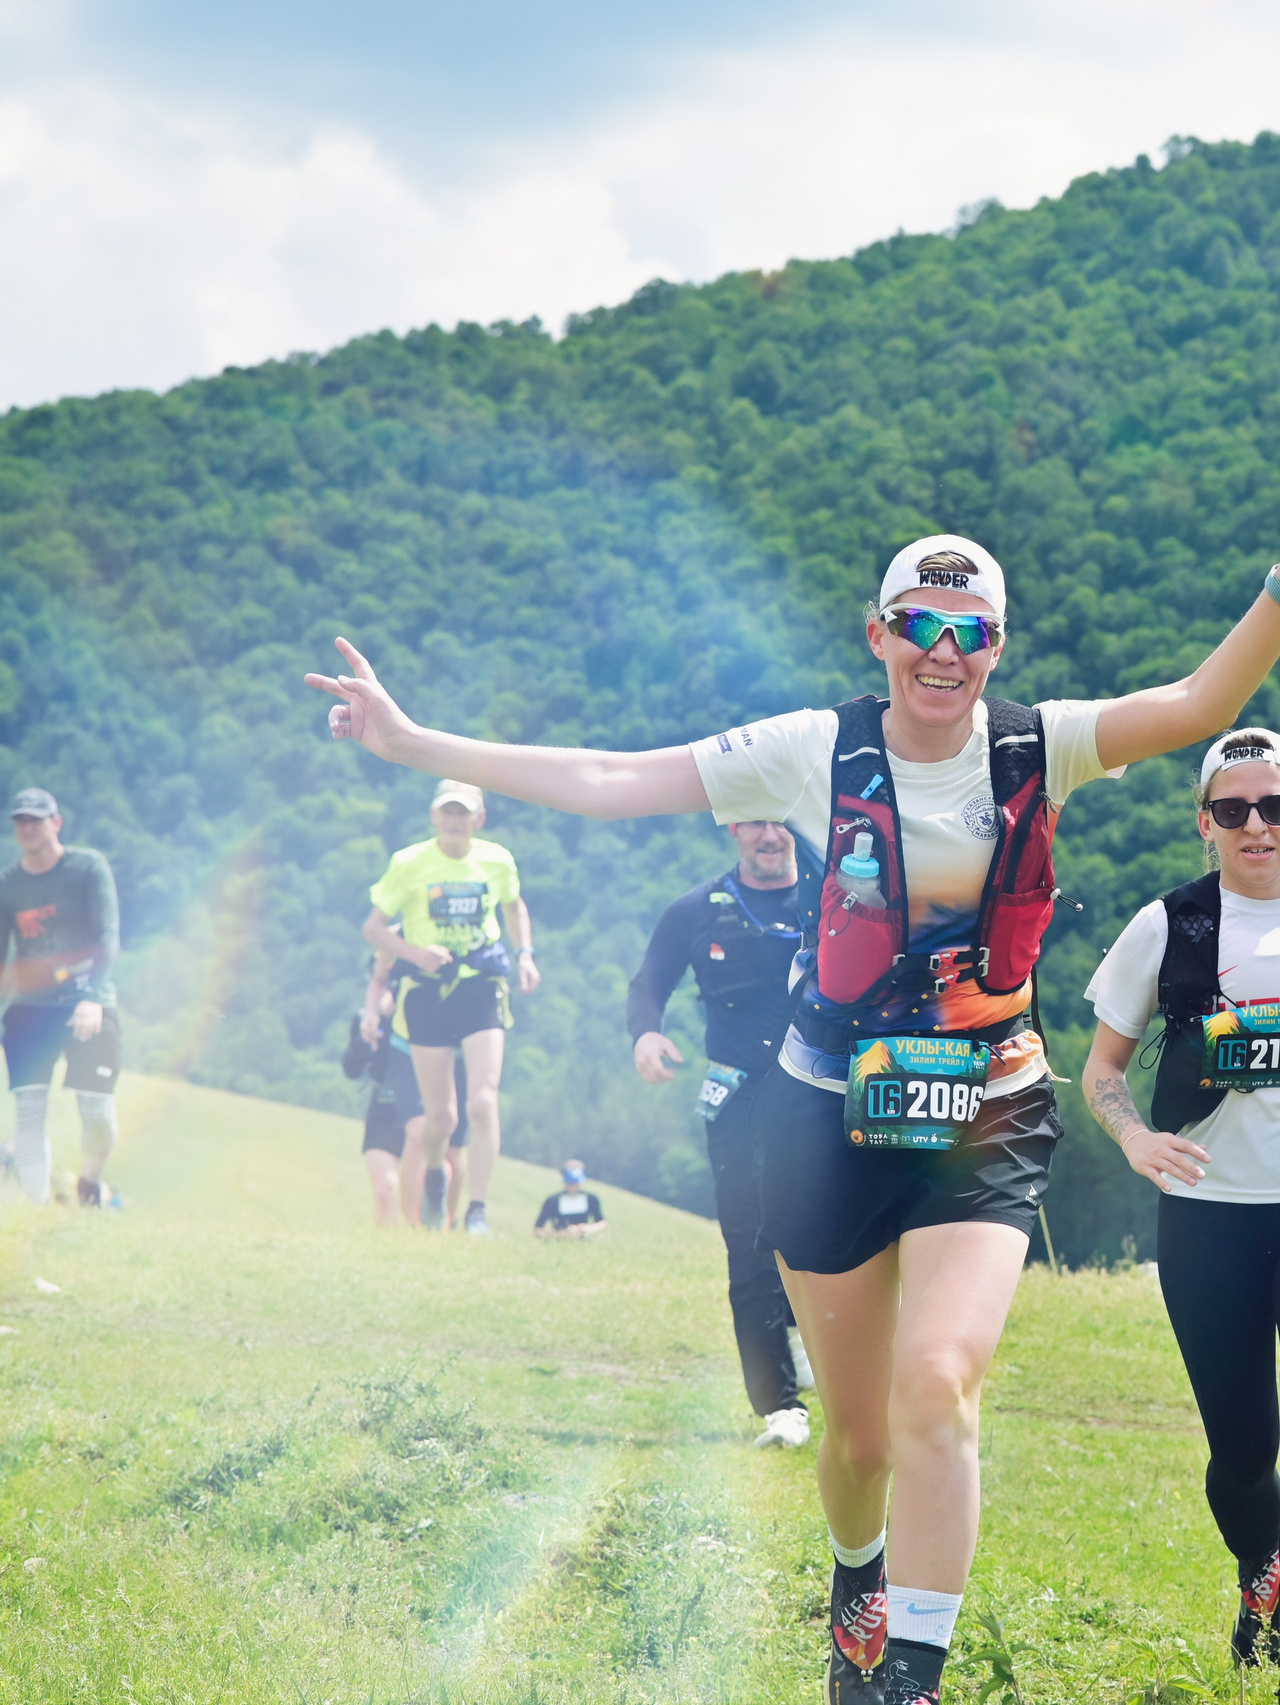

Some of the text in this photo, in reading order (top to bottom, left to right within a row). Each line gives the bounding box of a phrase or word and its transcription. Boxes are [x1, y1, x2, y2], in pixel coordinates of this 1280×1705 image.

[975, 830, 999, 838] МАРАФО
[895, 1039, 971, 1058] УКЛЫ-КАЯ
[1219, 1042, 1247, 1068] 16
[909, 1056, 936, 1064] ЗИЛИМ
[938, 1056, 960, 1066] ТРЕЙЛ
[869, 1080, 984, 1122] 16 2086
[912, 1135, 929, 1143] UTV
[841, 1592, 875, 1627] ALFA
[847, 1592, 886, 1646] RUN
